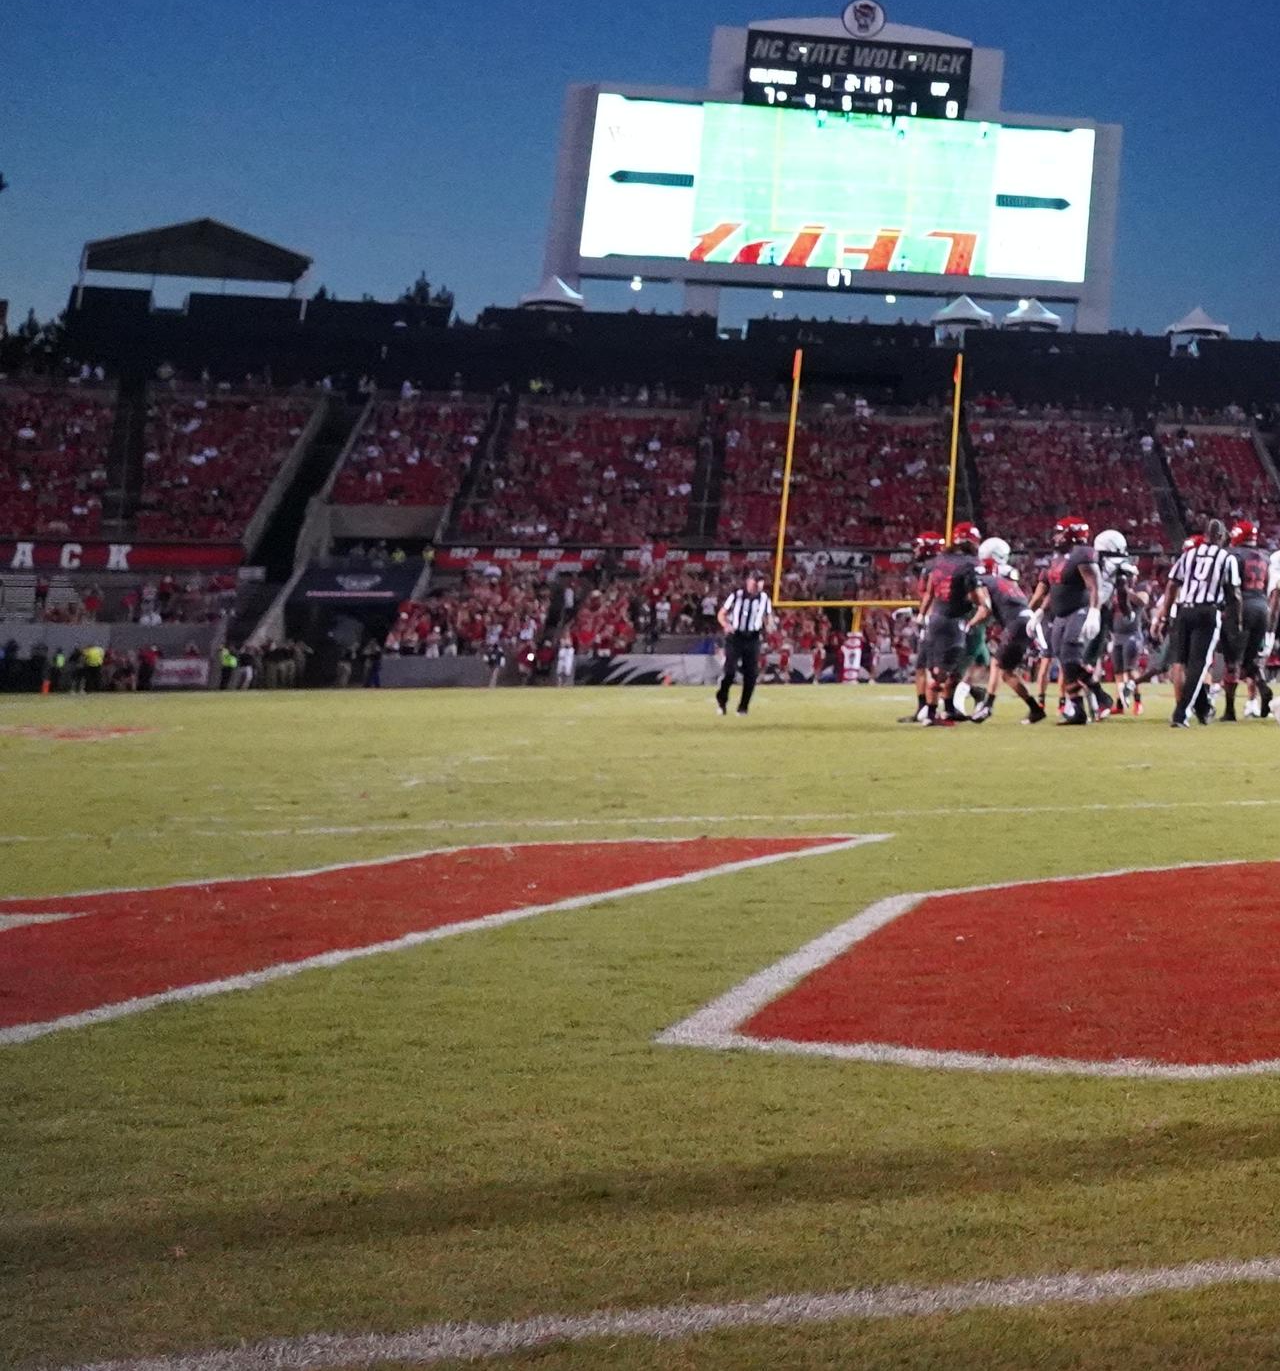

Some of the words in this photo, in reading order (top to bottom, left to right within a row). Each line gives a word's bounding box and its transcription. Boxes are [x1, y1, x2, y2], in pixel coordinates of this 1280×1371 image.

[752, 37, 784, 59] NC
[786, 41, 849, 66] STATE
[853, 45, 966, 75] WOLFPACK
